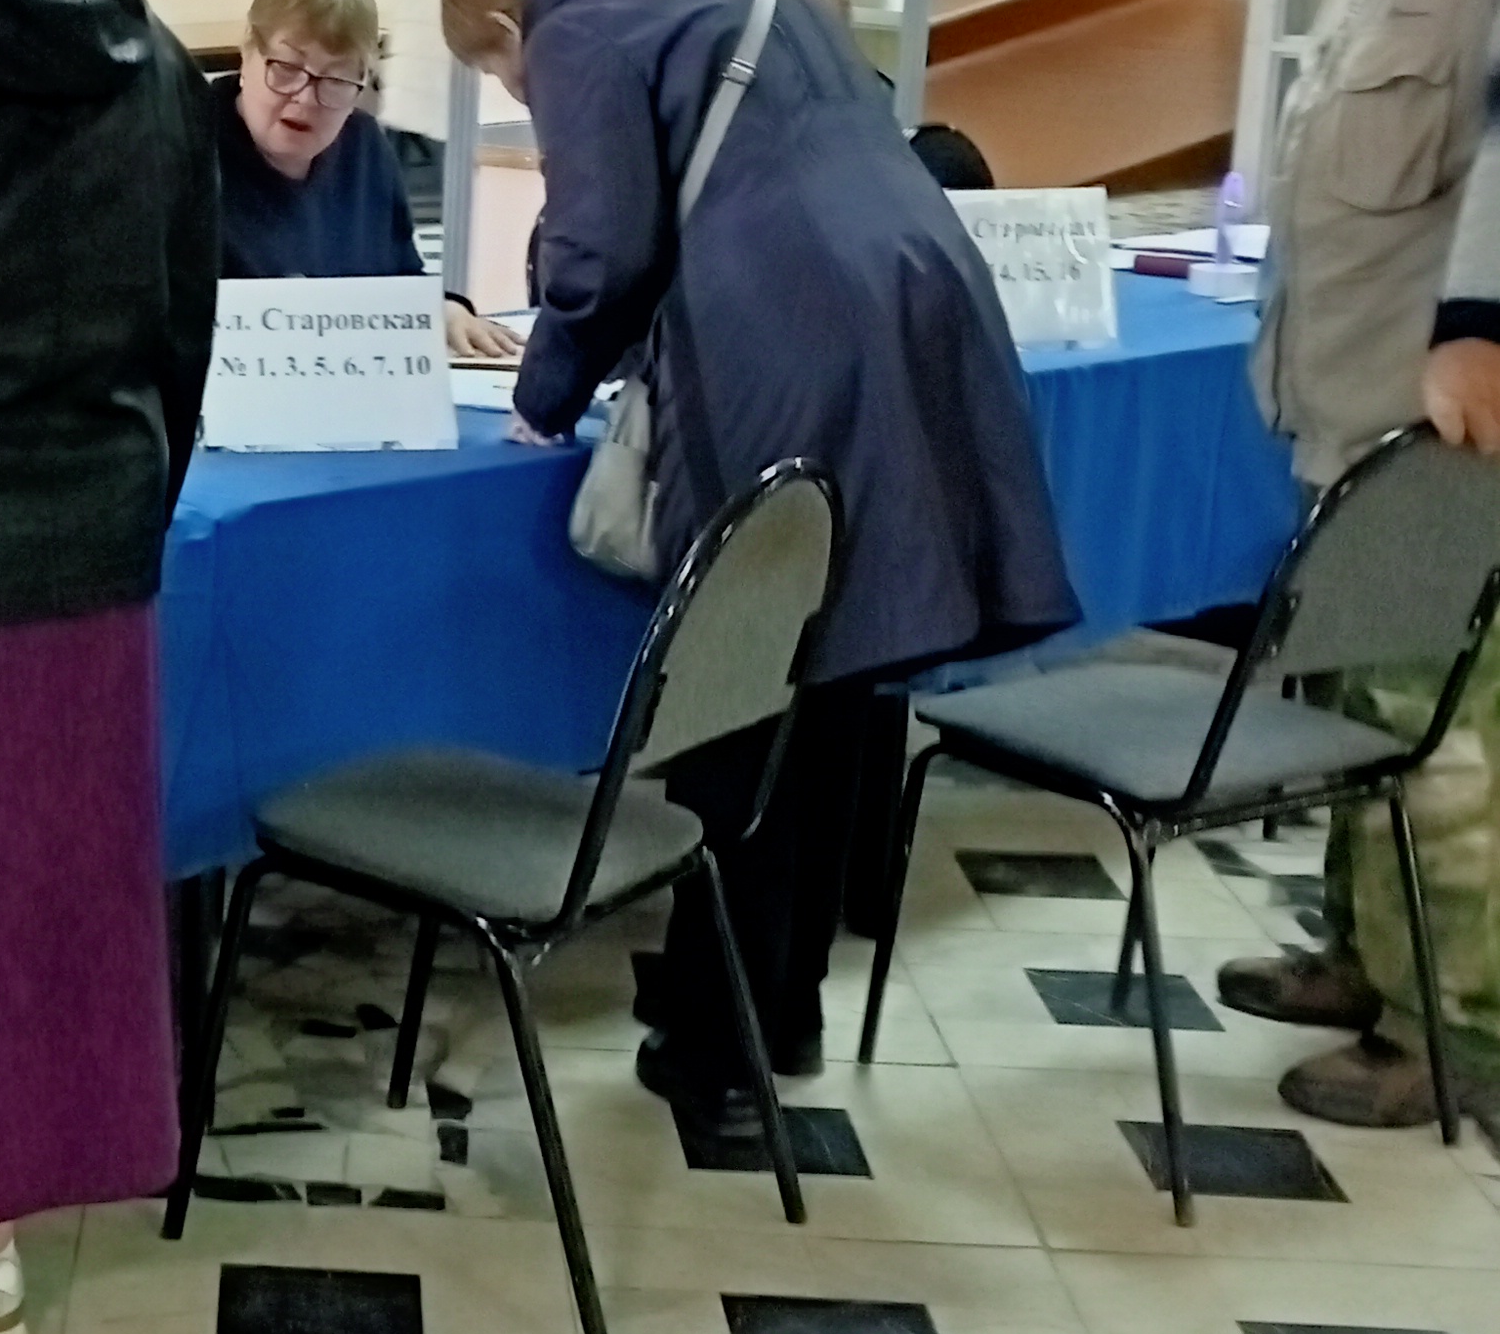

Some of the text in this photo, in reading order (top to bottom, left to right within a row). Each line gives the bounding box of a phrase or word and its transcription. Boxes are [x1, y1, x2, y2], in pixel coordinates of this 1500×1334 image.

[261, 308, 432, 337] Старовская
[217, 357, 247, 377] №
[404, 355, 431, 375] 10
